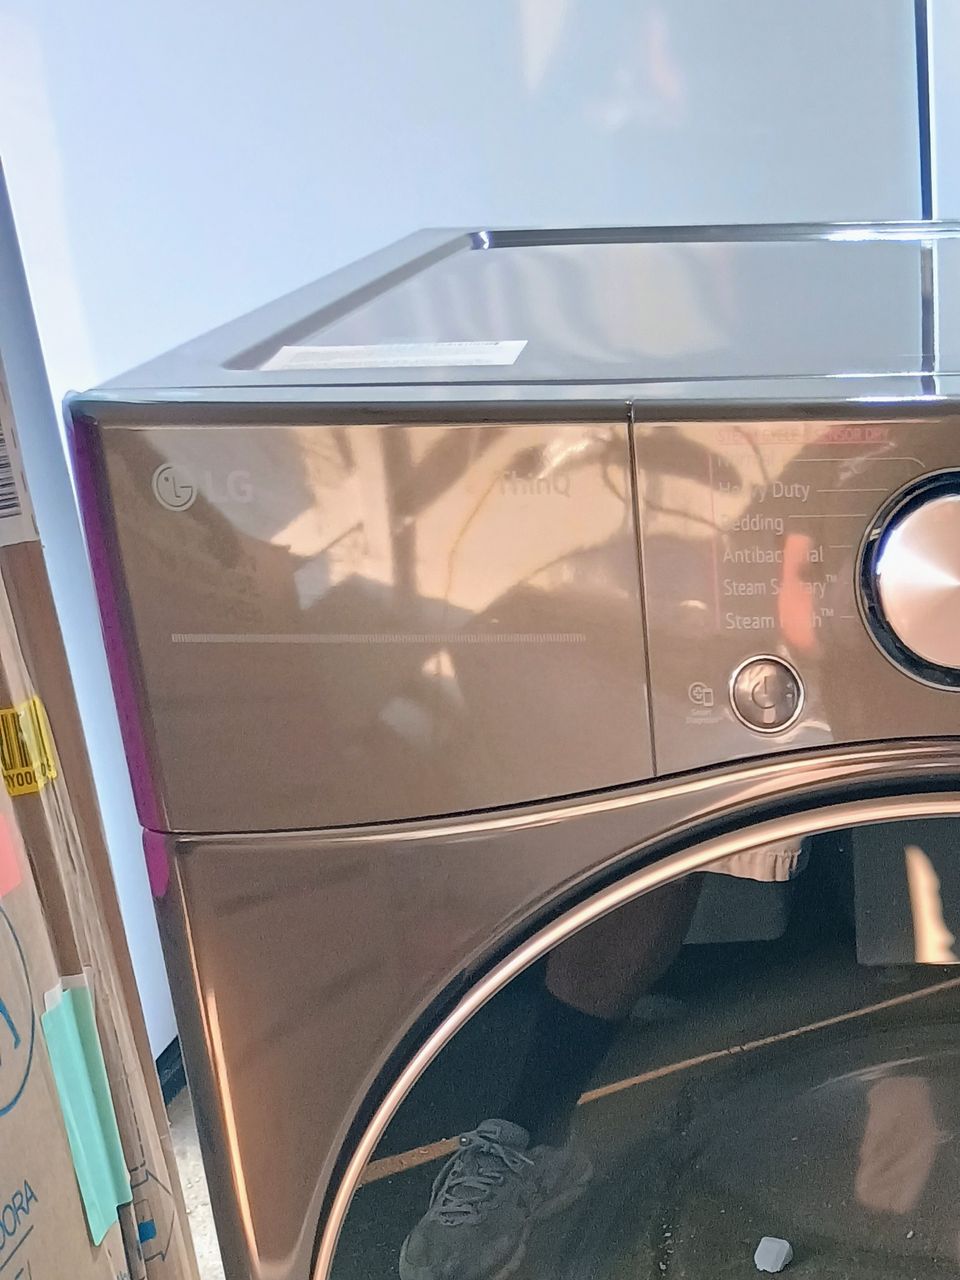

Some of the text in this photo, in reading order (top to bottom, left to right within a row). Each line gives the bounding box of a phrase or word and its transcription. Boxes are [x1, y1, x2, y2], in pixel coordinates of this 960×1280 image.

[204, 470, 255, 502] LG
[772, 481, 811, 502] Duty
[723, 545, 824, 563] Antibacial
[724, 579, 766, 596] Steam
[726, 612, 775, 629] Steam
